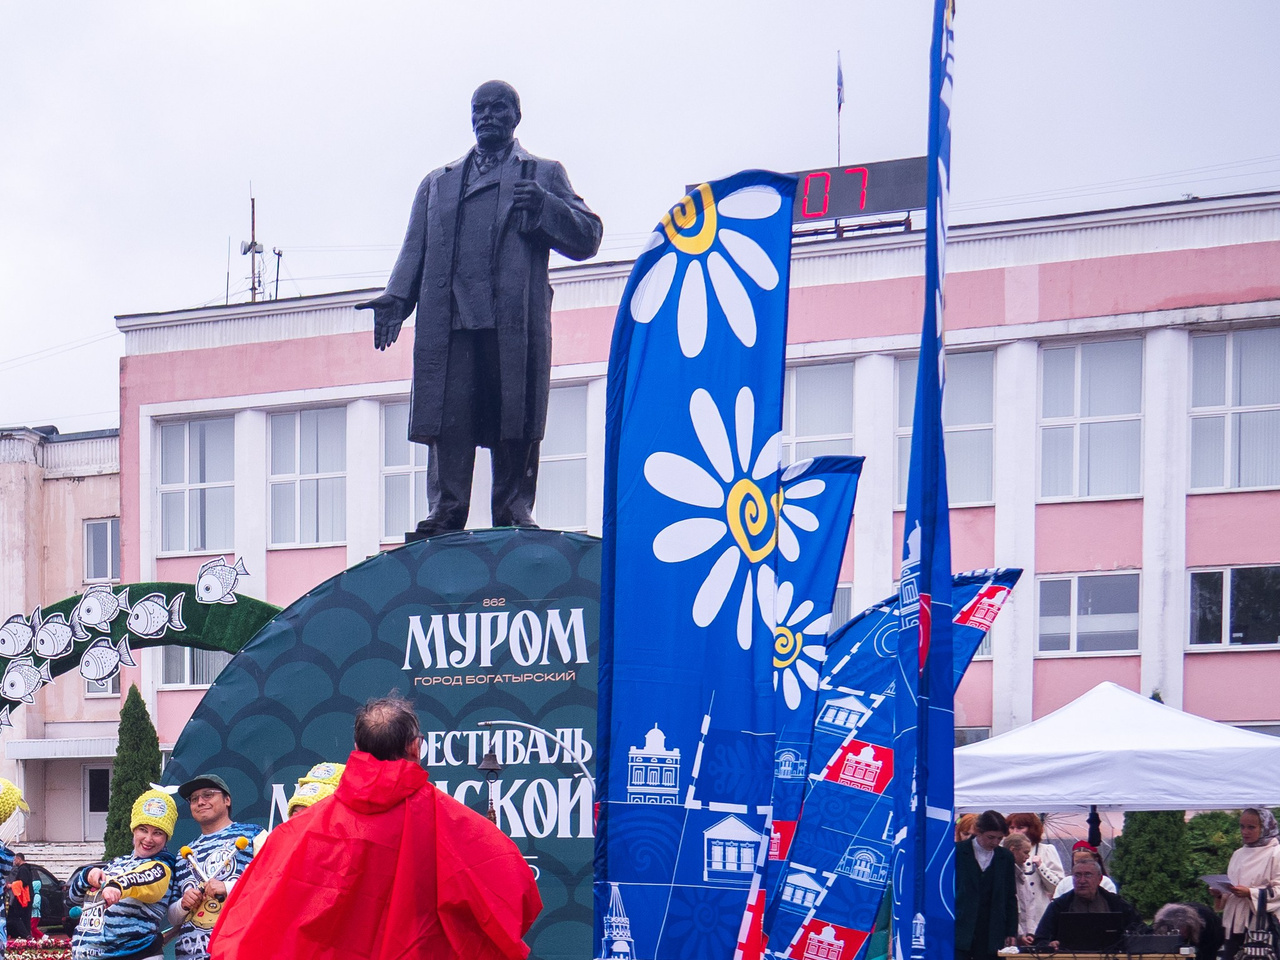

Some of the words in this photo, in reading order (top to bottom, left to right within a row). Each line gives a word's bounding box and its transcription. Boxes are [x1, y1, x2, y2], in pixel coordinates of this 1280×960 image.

[802, 167, 869, 219] 07
[482, 597, 506, 608] 862
[401, 608, 590, 670] МУРОМ
[414, 675, 462, 687] ГОРОД
[465, 670, 576, 685] БОГАТЫРСКИЙ
